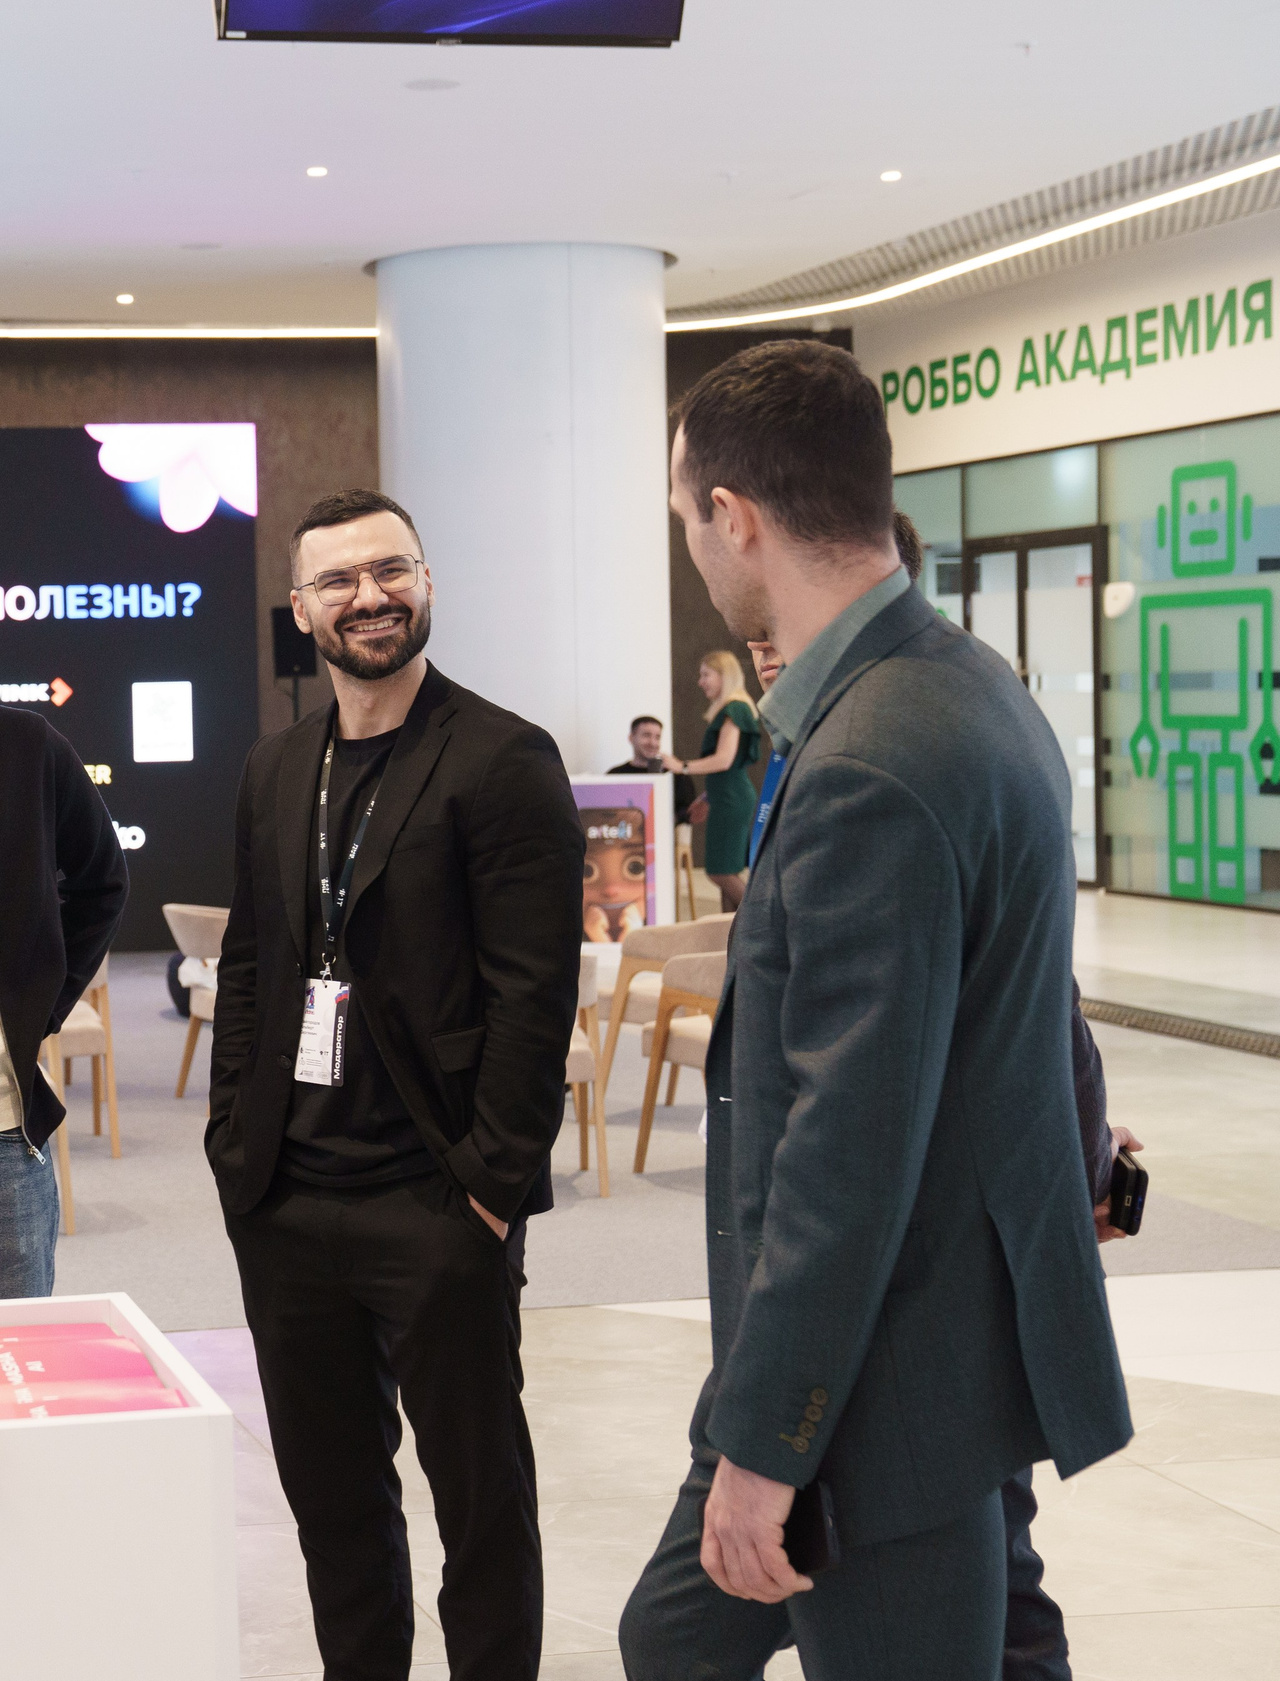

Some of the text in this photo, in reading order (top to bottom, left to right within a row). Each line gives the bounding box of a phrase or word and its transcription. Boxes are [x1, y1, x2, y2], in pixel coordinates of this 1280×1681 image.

[882, 279, 1273, 420] РОББО АКАДЕМИЯ
[333, 1016, 345, 1080] Модератор
